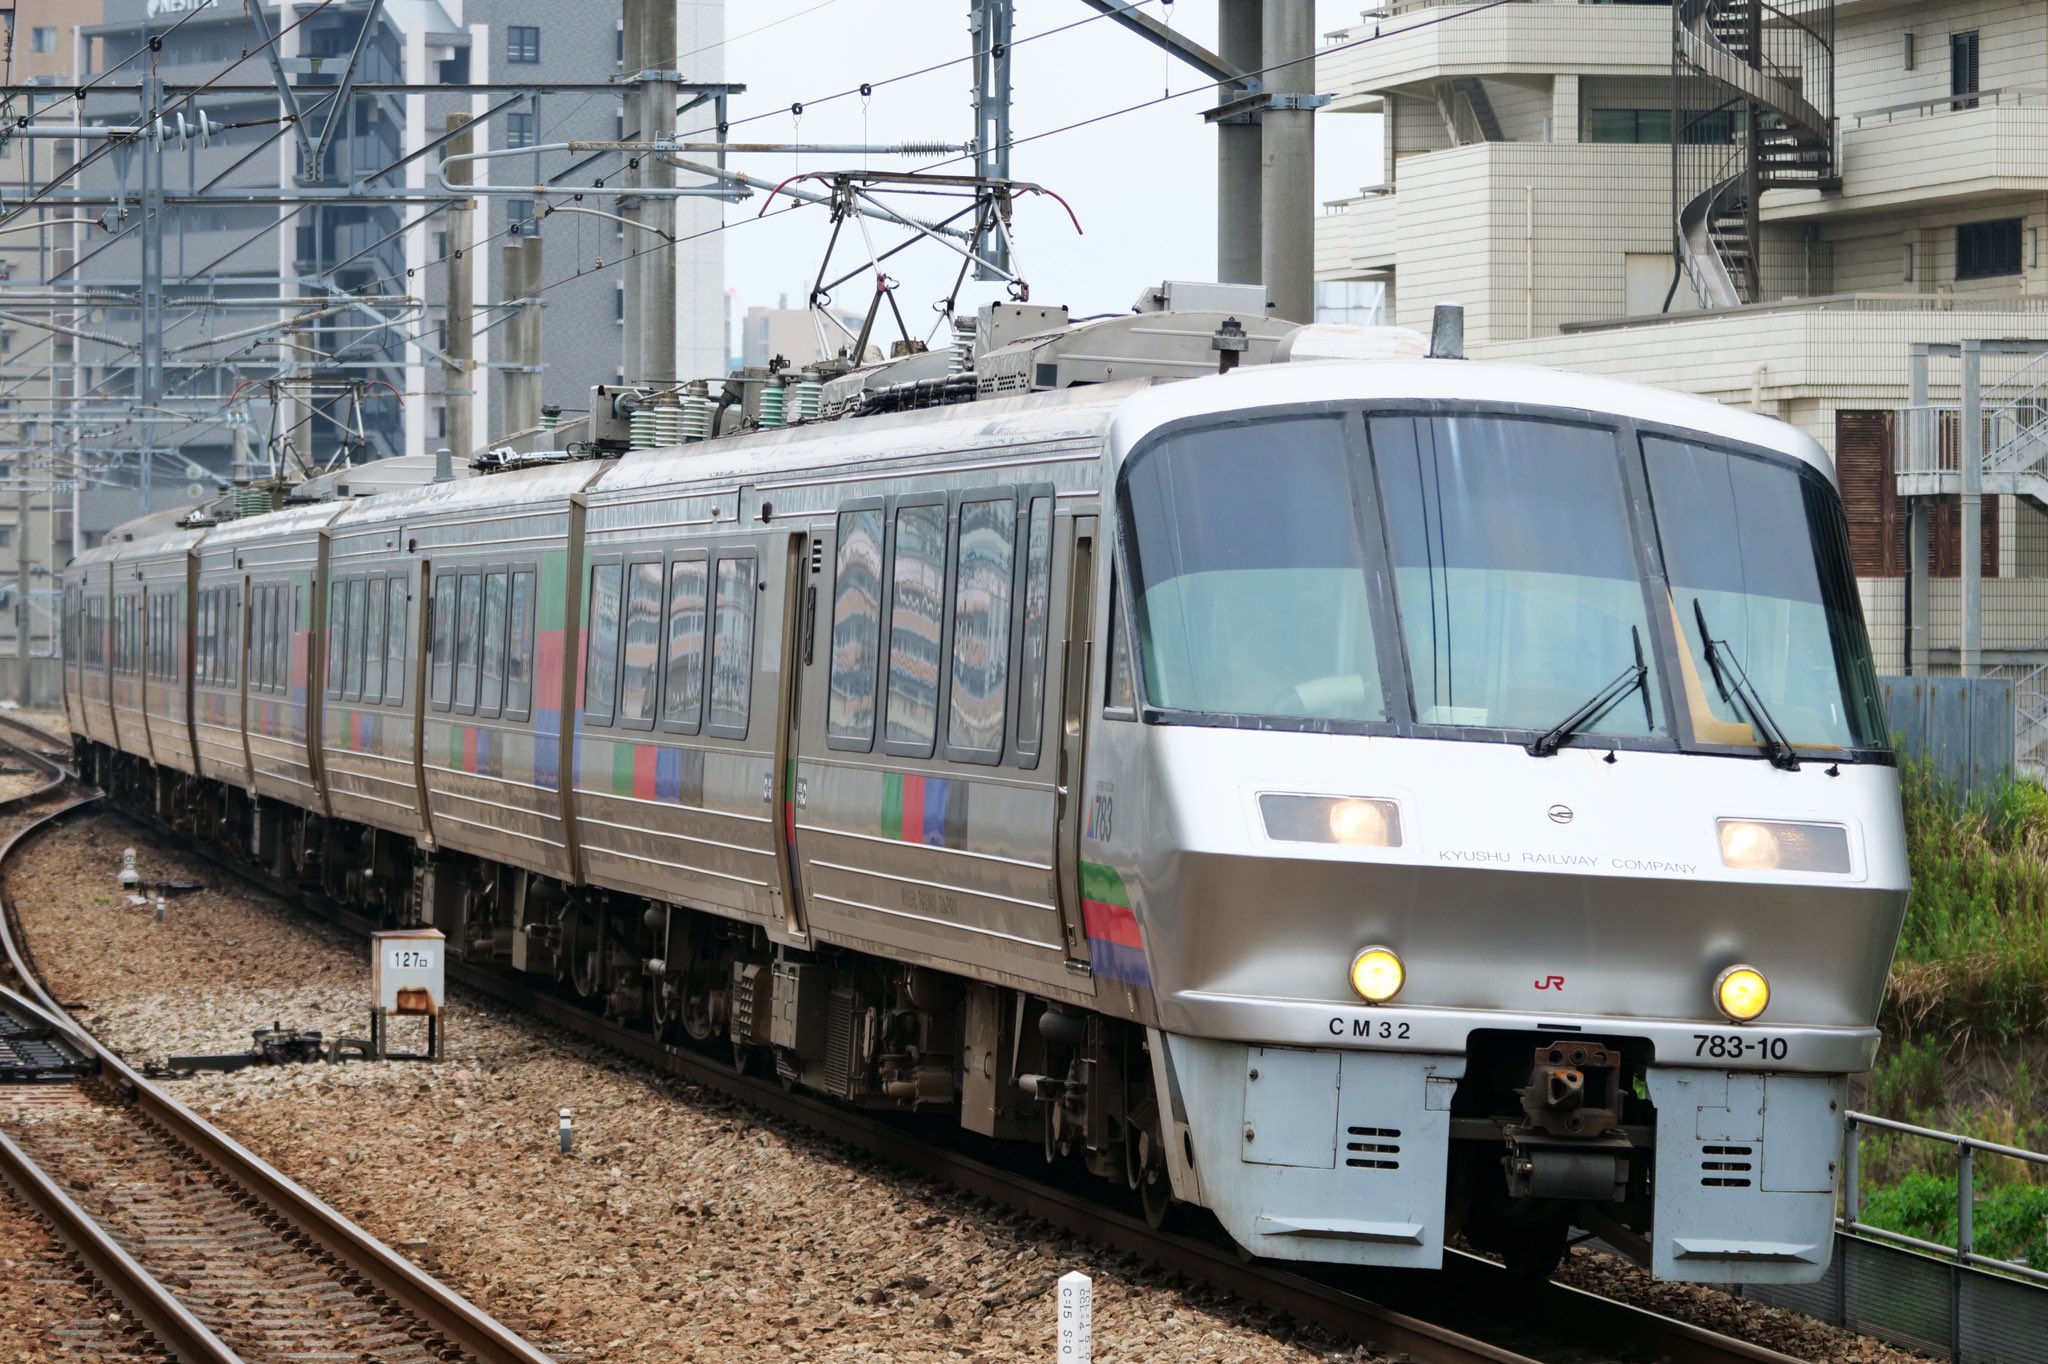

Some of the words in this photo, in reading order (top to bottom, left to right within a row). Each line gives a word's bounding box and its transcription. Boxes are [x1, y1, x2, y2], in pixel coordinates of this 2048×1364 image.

[1095, 795, 1113, 842] 783
[1439, 850, 1510, 862] KYUSHU
[1522, 852, 1598, 867] RAILWAY
[1611, 858, 1698, 875] COMPANY
[1534, 975, 1565, 991] JR
[1693, 1034, 1788, 1060] 783-10
